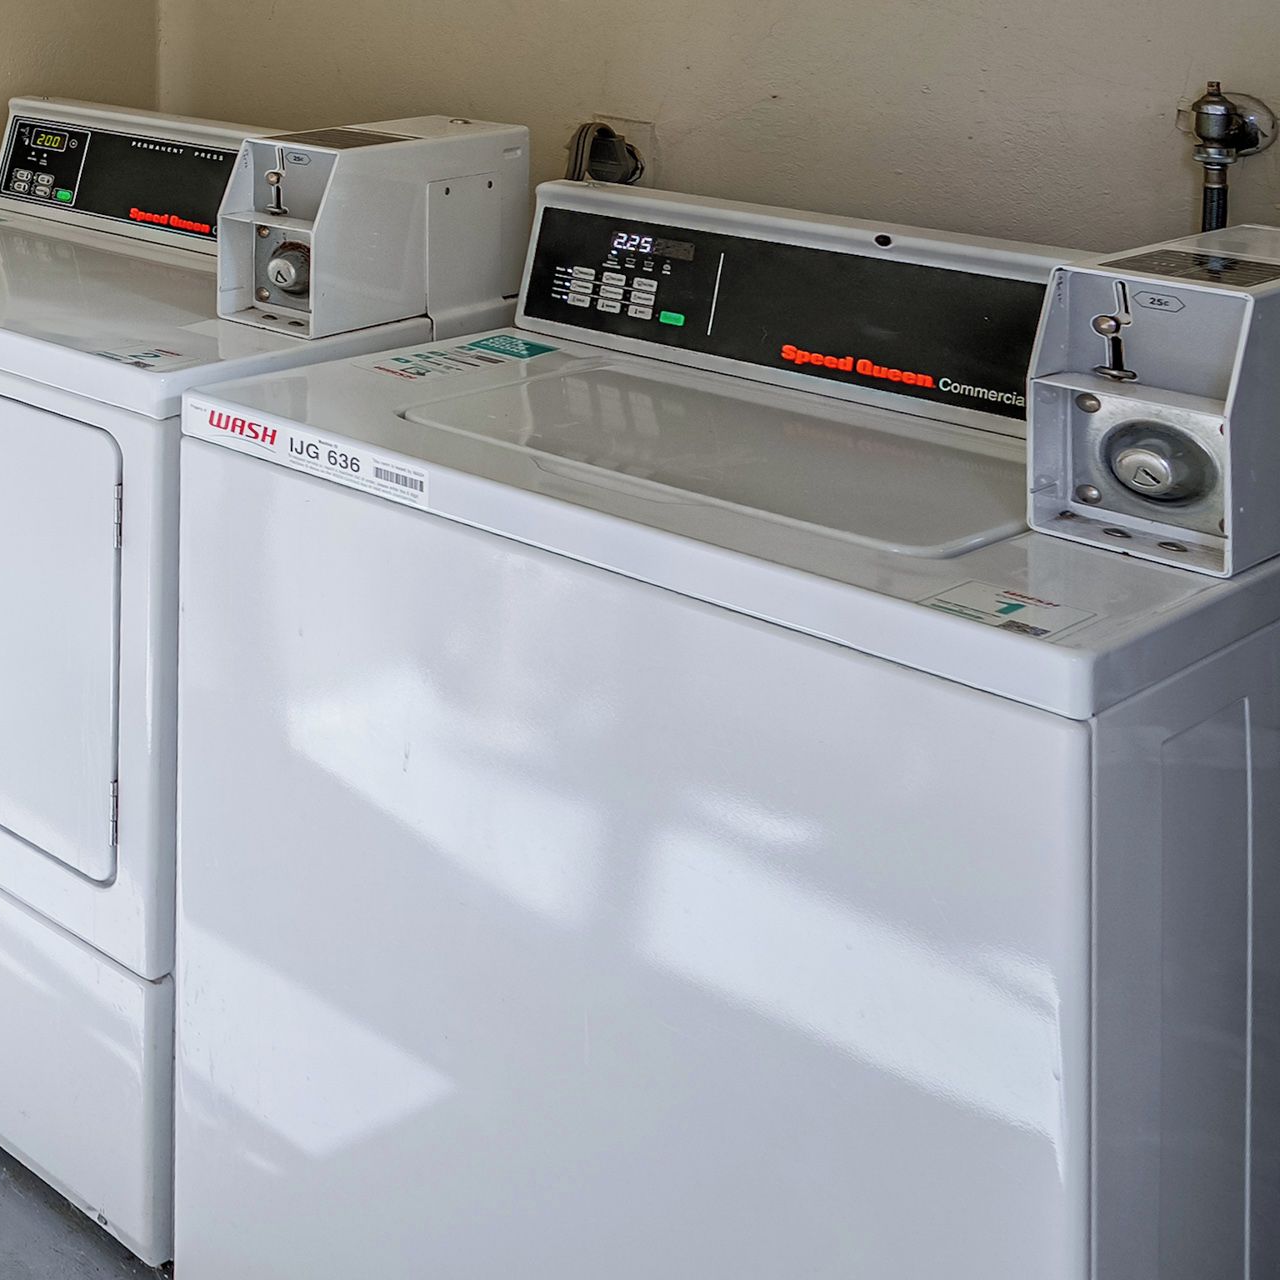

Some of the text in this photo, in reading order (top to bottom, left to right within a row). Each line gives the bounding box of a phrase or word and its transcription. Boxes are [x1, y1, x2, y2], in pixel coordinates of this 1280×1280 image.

[131, 141, 224, 162] PERMANENT PRESS
[129, 207, 169, 226] Speed
[169, 215, 211, 234] Queen
[780, 344, 1026, 408] Speed Queen Commercia
[208, 409, 278, 446] WASH
[289, 436, 320, 460] IJG
[327, 450, 361, 473] 636
